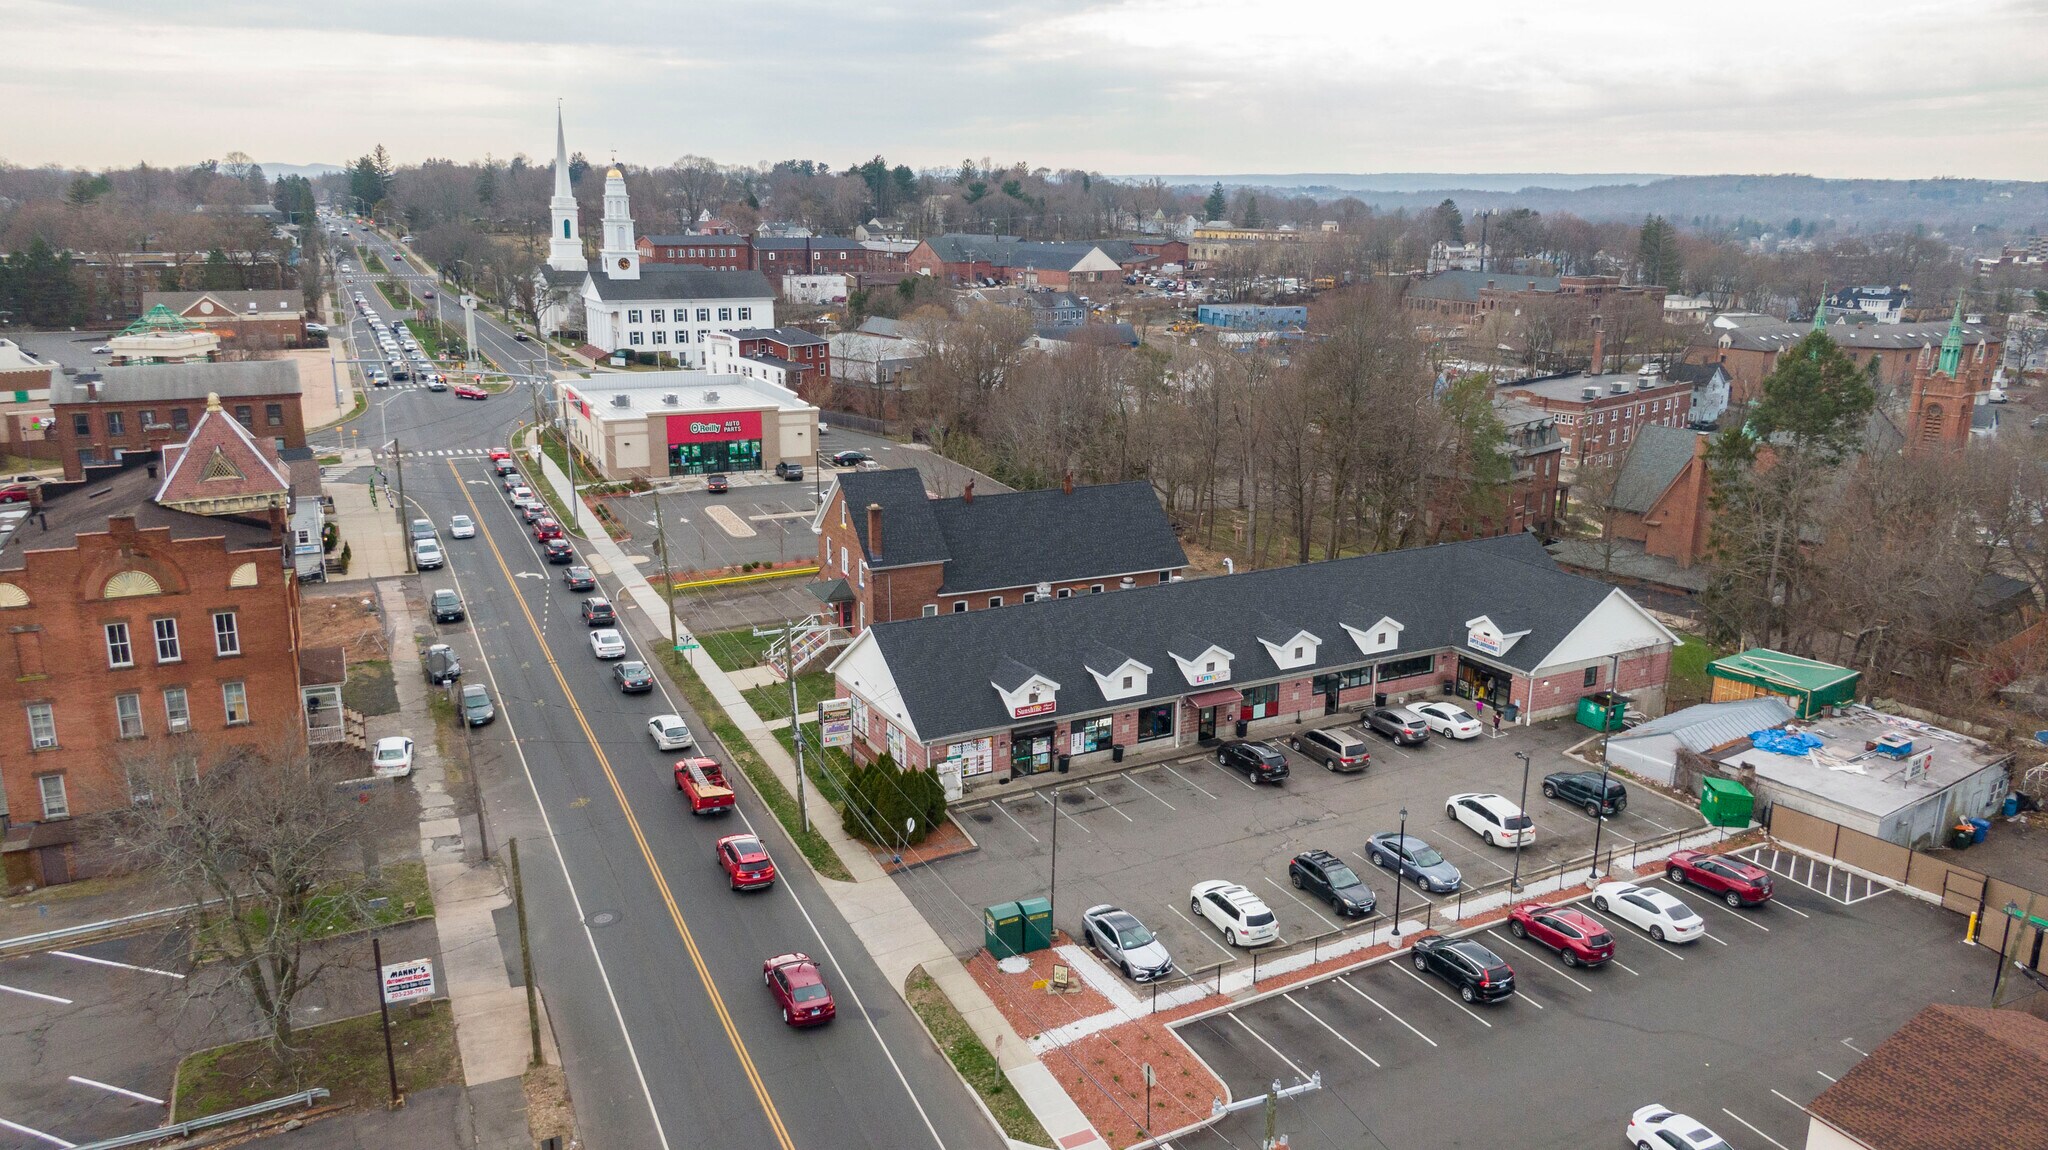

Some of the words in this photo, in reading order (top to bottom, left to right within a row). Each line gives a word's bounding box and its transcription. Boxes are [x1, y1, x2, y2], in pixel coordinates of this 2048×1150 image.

[690, 421, 721, 434] O'Reilly
[1016, 705, 1042, 715] Sunshine
[390, 966, 426, 978] MANNY'S
